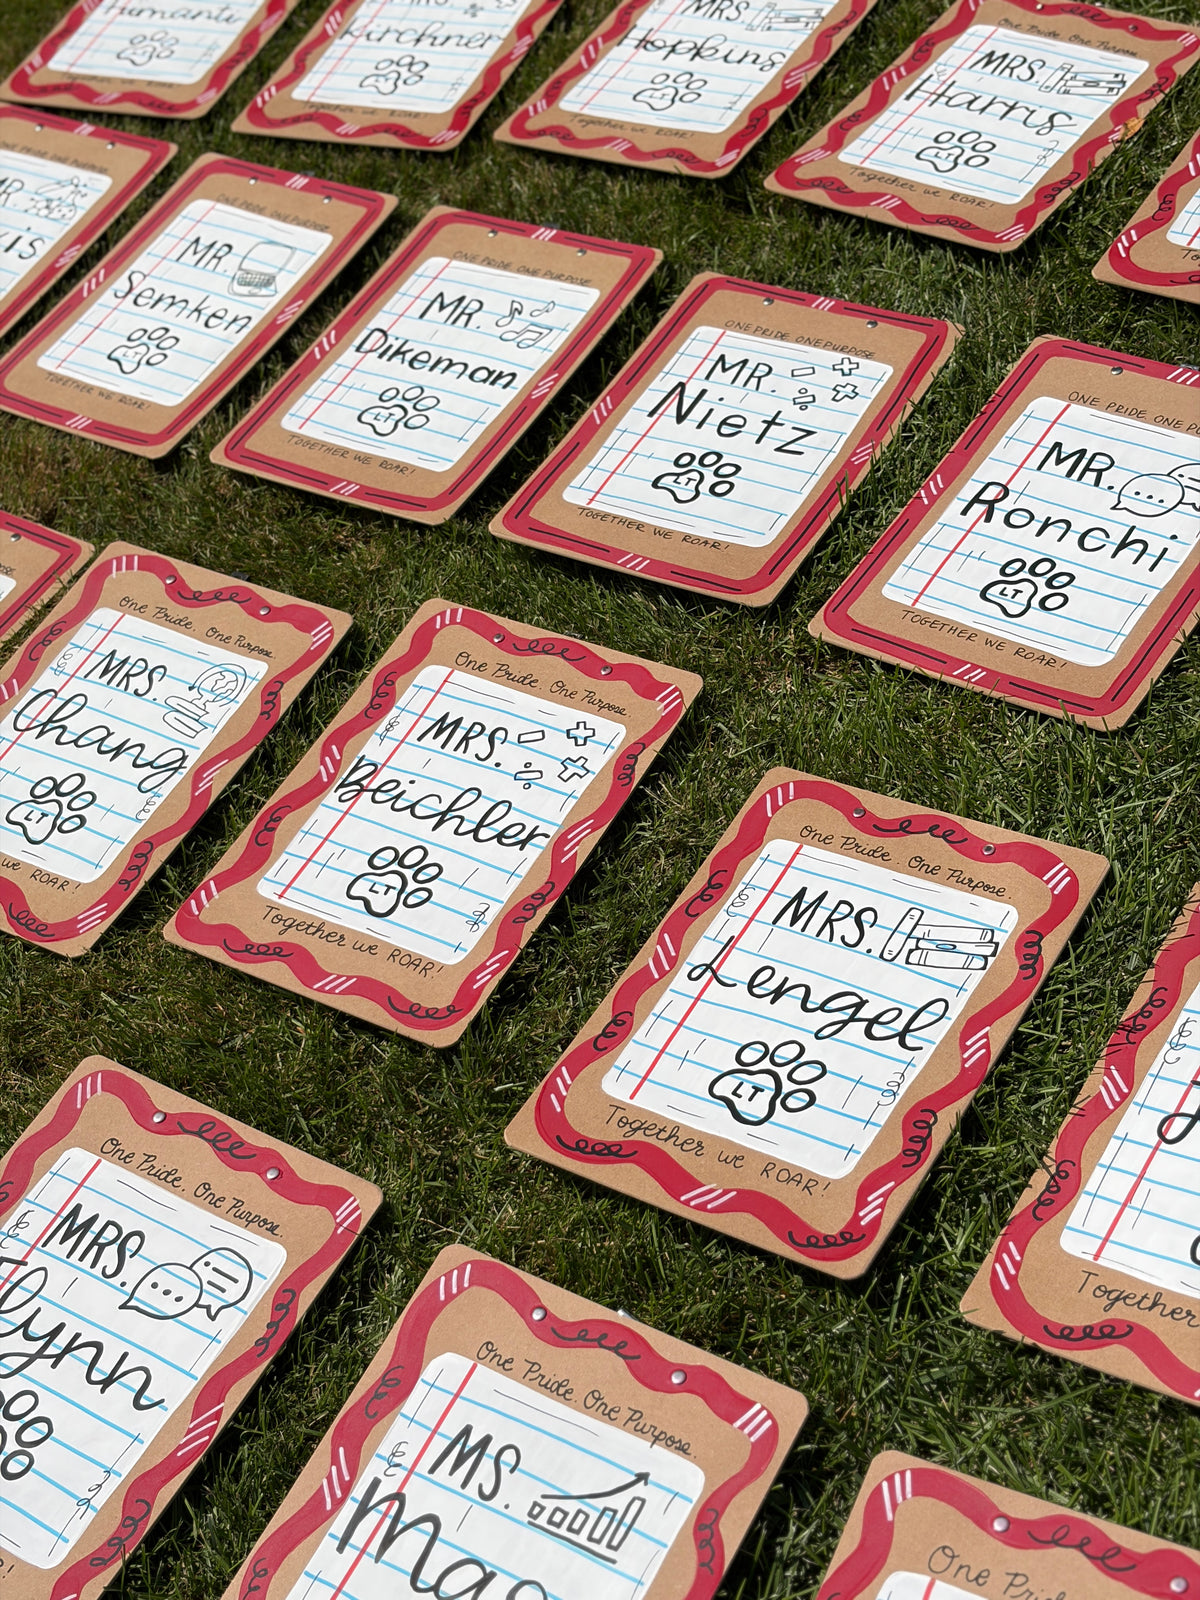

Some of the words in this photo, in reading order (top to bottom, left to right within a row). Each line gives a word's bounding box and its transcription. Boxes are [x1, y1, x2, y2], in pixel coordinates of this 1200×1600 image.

[617, 24, 786, 72] Hopkins
[969, 50, 1046, 83] MRS.
[904, 73, 1077, 136] Harris
[934, 150, 953, 161] LT
[849, 167, 917, 192] Together
[923, 188, 941, 198] we
[949, 193, 993, 209] ROAR!
[176, 236, 232, 272] MR.
[113, 270, 252, 335] Semken
[419, 291, 484, 330] MR.
[724, 319, 752, 332] ONE
[795, 336, 824, 348] ONE
[354, 328, 518, 390] Dikeman
[704, 354, 776, 393] MR.
[374, 410, 395, 425] LT
[647, 381, 818, 456] Nietz
[1068, 391, 1100, 407] ONE
[1153, 414, 1184, 429] ONE
[287, 434, 349, 459] TOGETHER
[353, 452, 373, 465] WE
[378, 459, 416, 477] ROAR!
[1037, 441, 1115, 491] MR.
[672, 474, 697, 488] LT
[577, 506, 646, 533] TOGETHER
[653, 527, 674, 540] WE
[681, 534, 730, 553] ROAR!
[959, 481, 1179, 573] Ronchi
[998, 587, 1023, 600] LT
[119, 595, 149, 614] One
[205, 626, 233, 644] One
[900, 609, 978, 643] TOGETHER
[984, 637, 1007, 651] WE
[1014, 646, 1068, 671] ROAR!
[84, 649, 167, 702] MRS.
[455, 651, 488, 672] One
[549, 680, 579, 700] One
[12, 688, 189, 794] Chang
[417, 711, 509, 768] MRS.
[24, 809, 49, 825] LT
[334, 754, 551, 851] Beichler
[1, 858, 22, 871] we
[799, 824, 833, 848] One
[907, 854, 941, 877] One
[368, 881, 397, 897] LT
[264, 905, 346, 947] Together
[353, 939, 380, 956] we
[387, 949, 445, 980] ROAR!
[772, 885, 878, 955] MRS.
[687, 935, 950, 1052] Lengel
[731, 1081, 765, 1103] LT
[100, 1136, 136, 1167] One
[193, 1181, 228, 1210] One
[605, 1103, 705, 1156] Together
[717, 1150, 745, 1169] we
[759, 1162, 830, 1198] ROAR!
[41, 1203, 145, 1289] MRS.
[1081, 1269, 1200, 1328] Together
[0, 1256, 165, 1411] lynn
[477, 1340, 515, 1373] One
[583, 1388, 620, 1422] One
[428, 1423, 522, 1510] MS.
[927, 1544, 991, 1587] One
